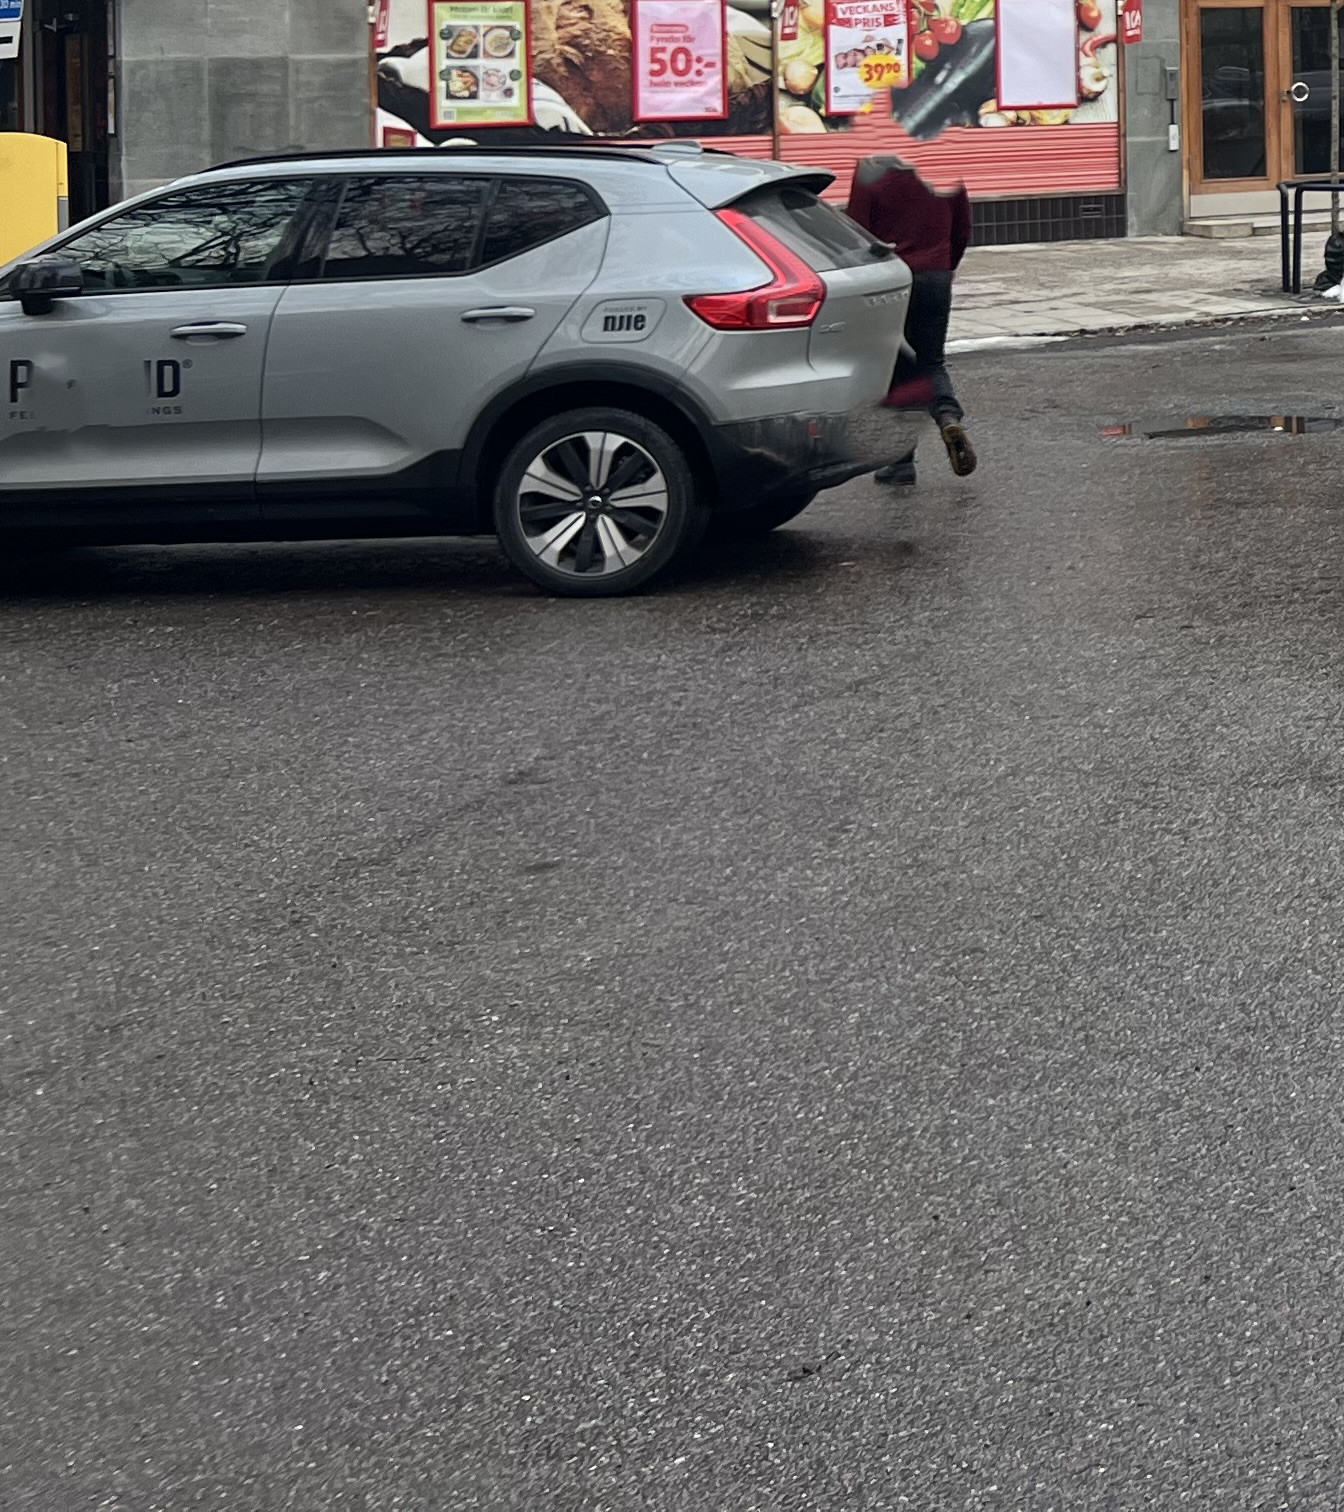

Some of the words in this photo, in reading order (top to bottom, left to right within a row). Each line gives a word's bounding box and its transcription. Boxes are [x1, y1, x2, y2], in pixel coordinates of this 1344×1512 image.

[839, 2, 896, 16] VECKANS
[853, 17, 883, 28] PRIS
[648, 46, 717, 78] 50:-
